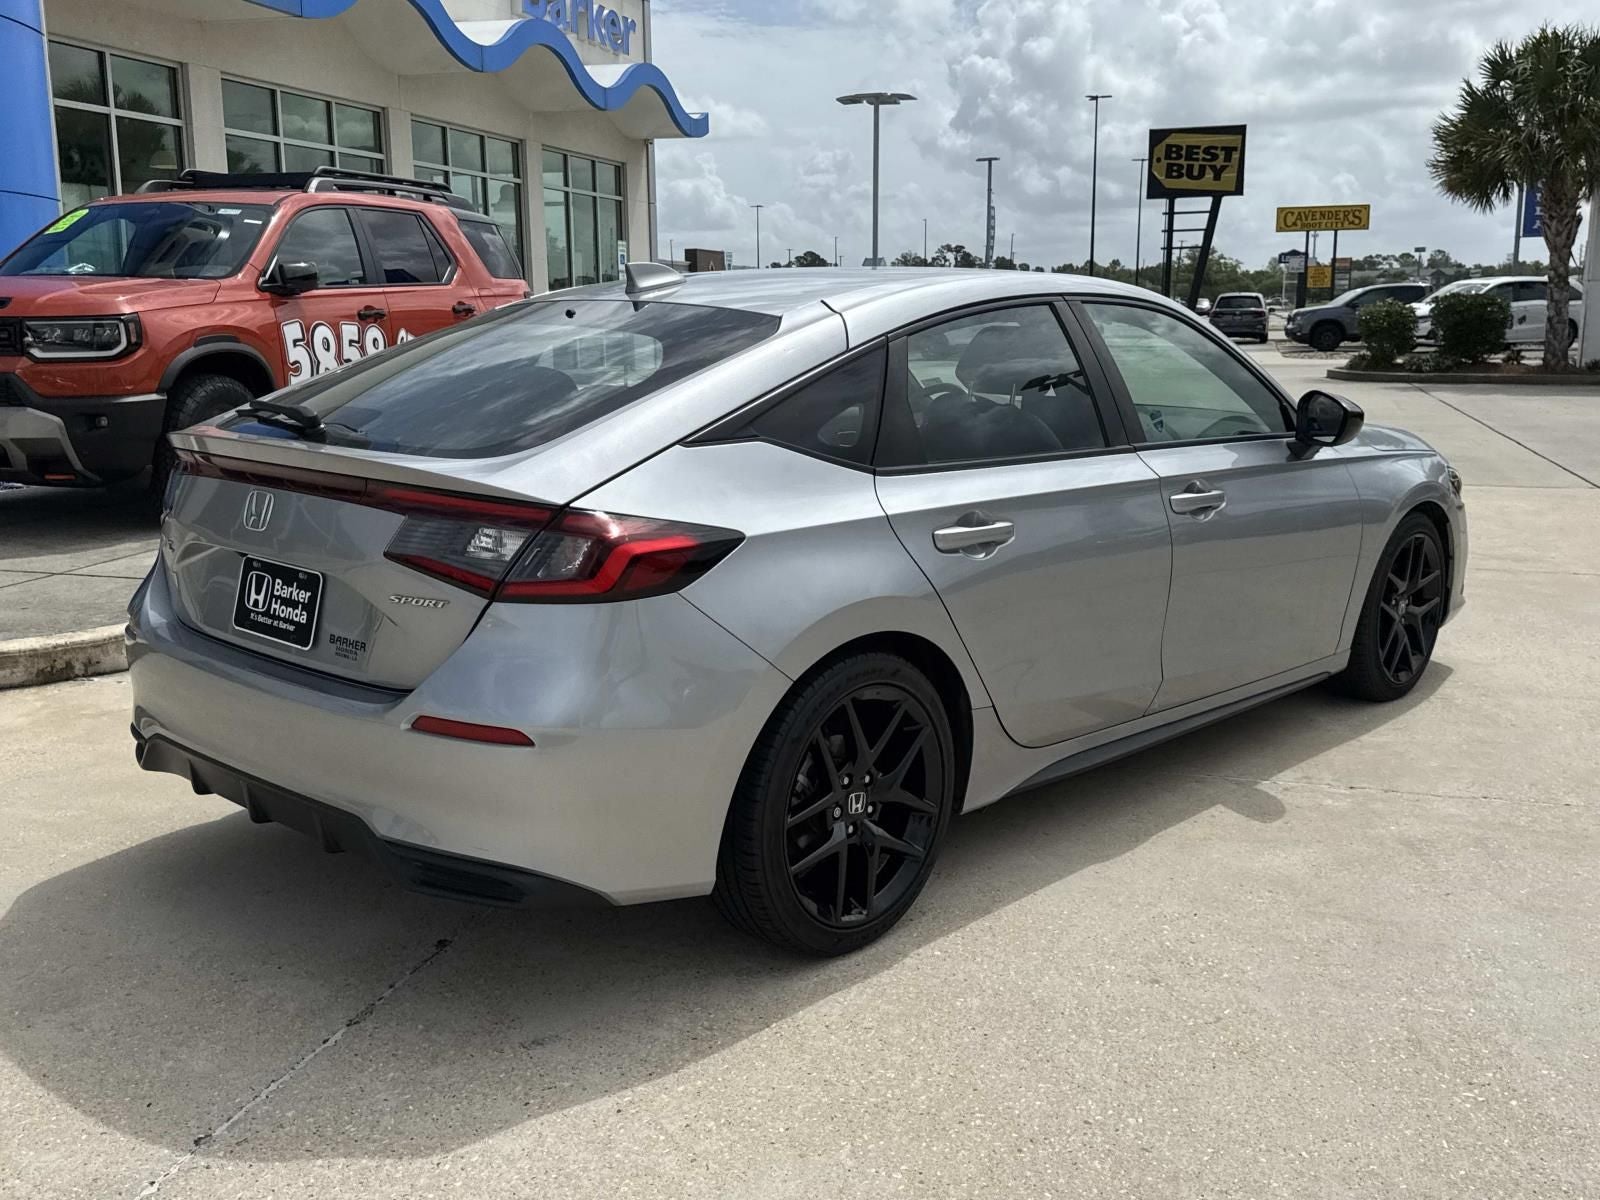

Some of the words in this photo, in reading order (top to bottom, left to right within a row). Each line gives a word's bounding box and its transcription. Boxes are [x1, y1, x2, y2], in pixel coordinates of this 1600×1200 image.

[1164, 143, 1239, 163] BEST
[1165, 162, 1230, 182] BUY
[1283, 208, 1363, 229] CAVENDER'S
[1300, 220, 1323, 230] BOOT
[1324, 220, 1346, 230] CITY
[273, 578, 312, 604] Barker
[389, 594, 450, 608] SPORT
[270, 597, 307, 624] Honda
[329, 633, 367, 652] BARKER
